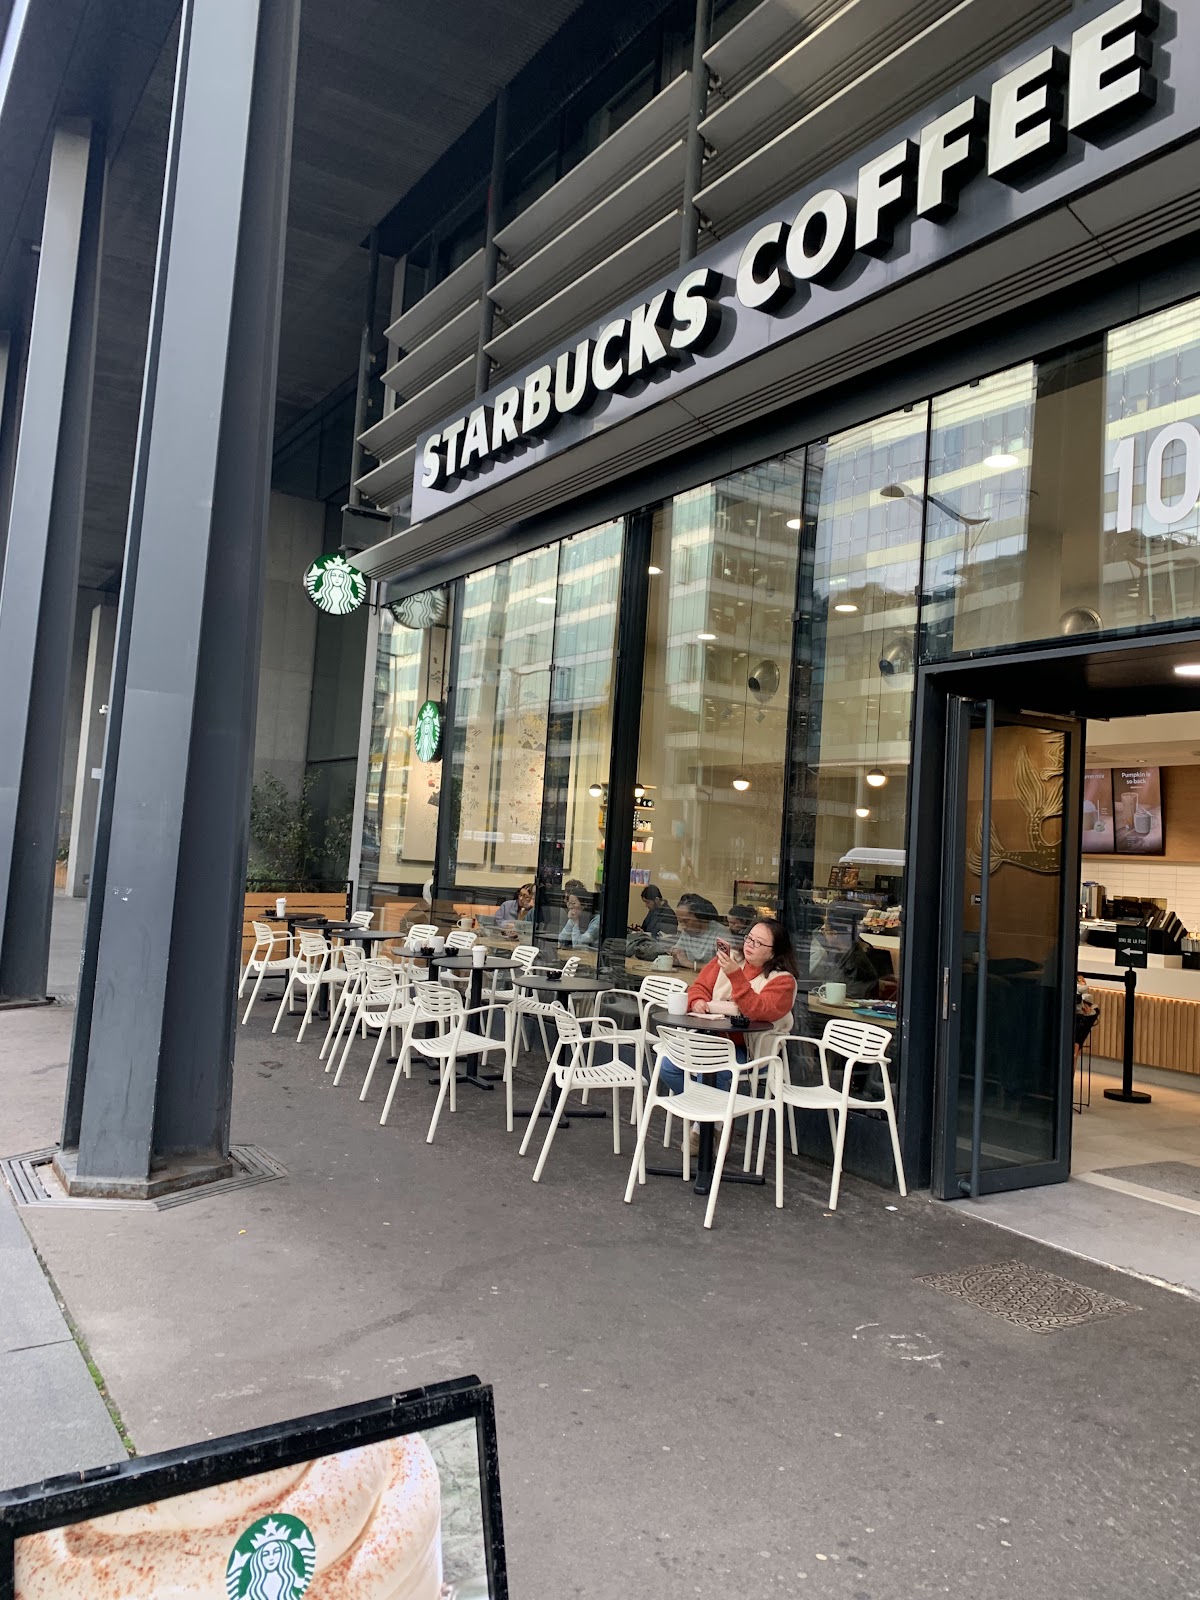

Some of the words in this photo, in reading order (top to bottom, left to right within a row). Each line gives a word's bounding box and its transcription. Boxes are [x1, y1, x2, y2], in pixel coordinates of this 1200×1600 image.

[420, 267, 709, 488] STARBUCKS
[736, 0, 1144, 309] COFFEE
[1112, 421, 1200, 534] 10
